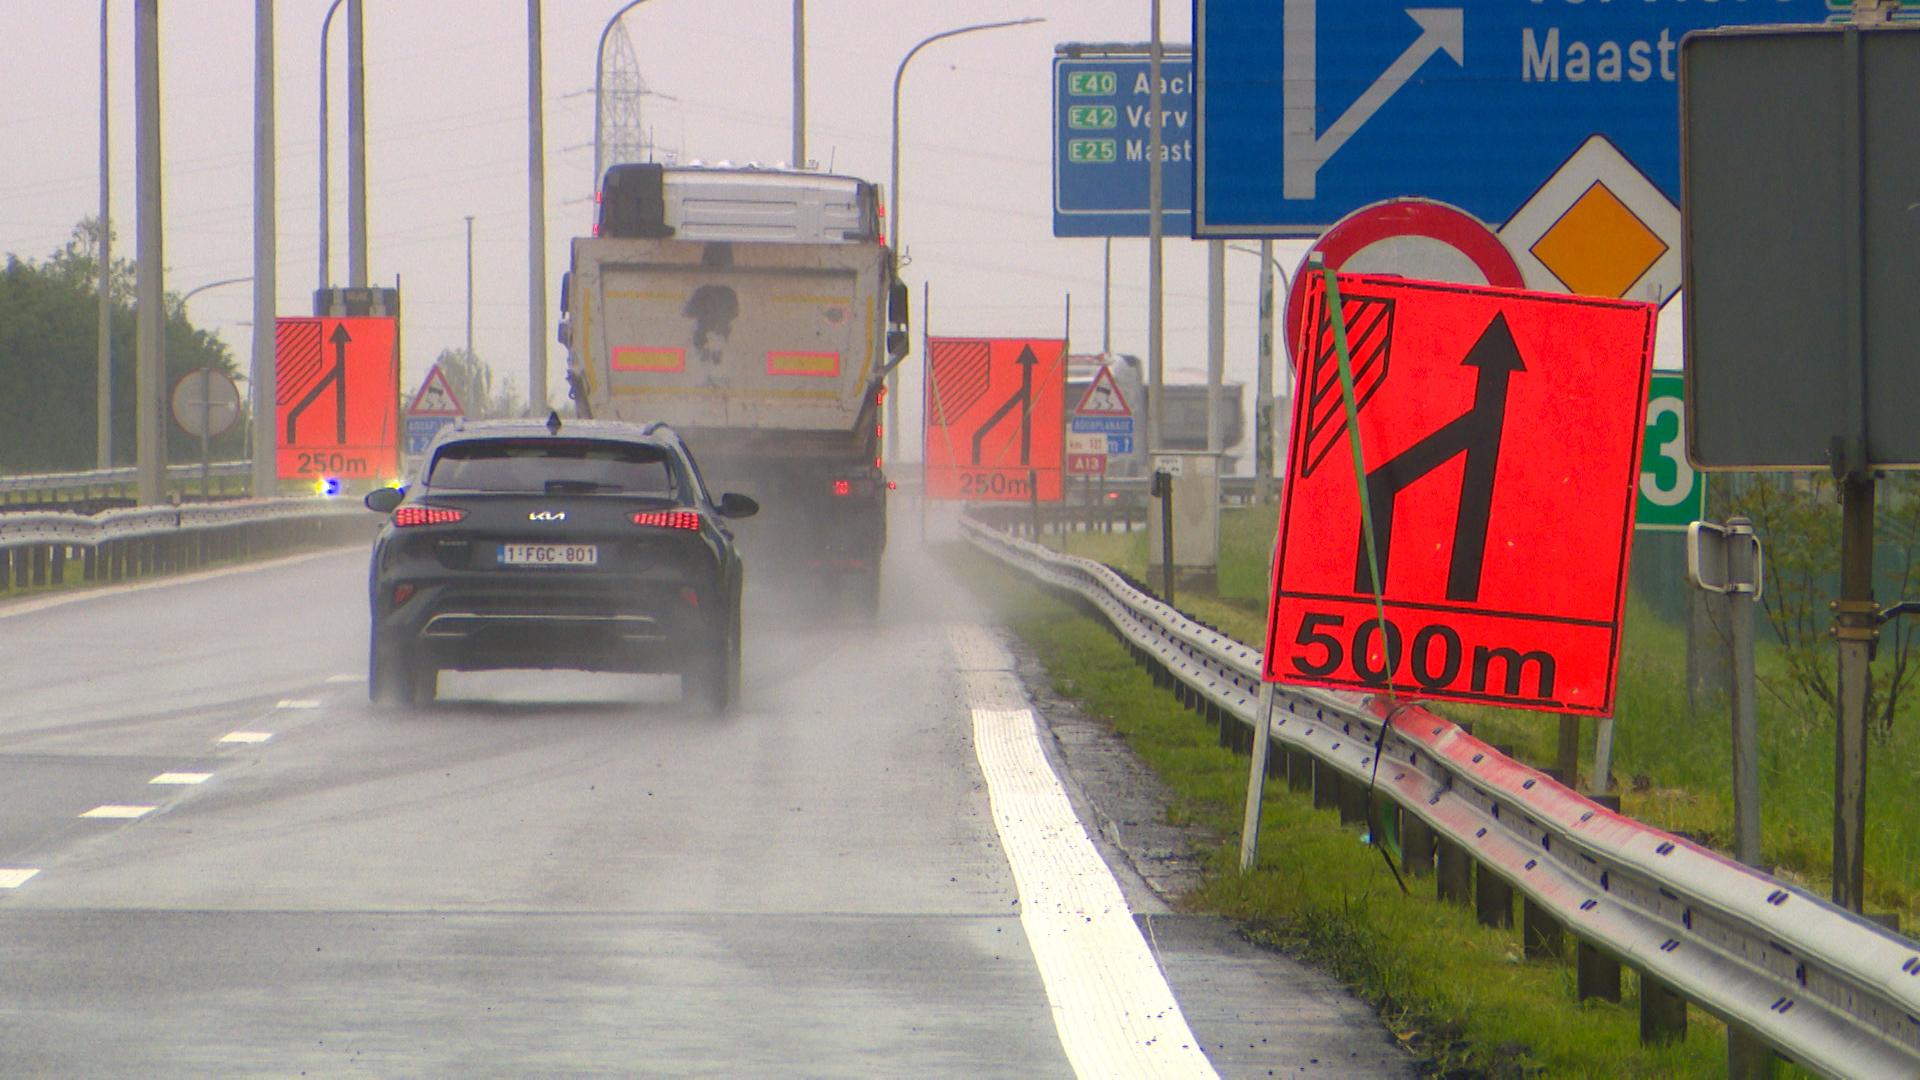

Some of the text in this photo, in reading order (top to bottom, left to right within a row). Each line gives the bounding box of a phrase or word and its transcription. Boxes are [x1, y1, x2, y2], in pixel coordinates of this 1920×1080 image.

[1522, 27, 1676, 82] Maast
[1072, 75, 1114, 94] E40
[1072, 109, 1114, 127] E42
[1072, 142, 1114, 159] E25
[1639, 396, 1694, 506] 3
[297, 452, 367, 474] 250m
[960, 472, 1028, 495] 250m
[528, 511, 567, 520] KIA
[508, 547, 595, 562] 1-FGC-801
[1291, 612, 1556, 699] 500m
